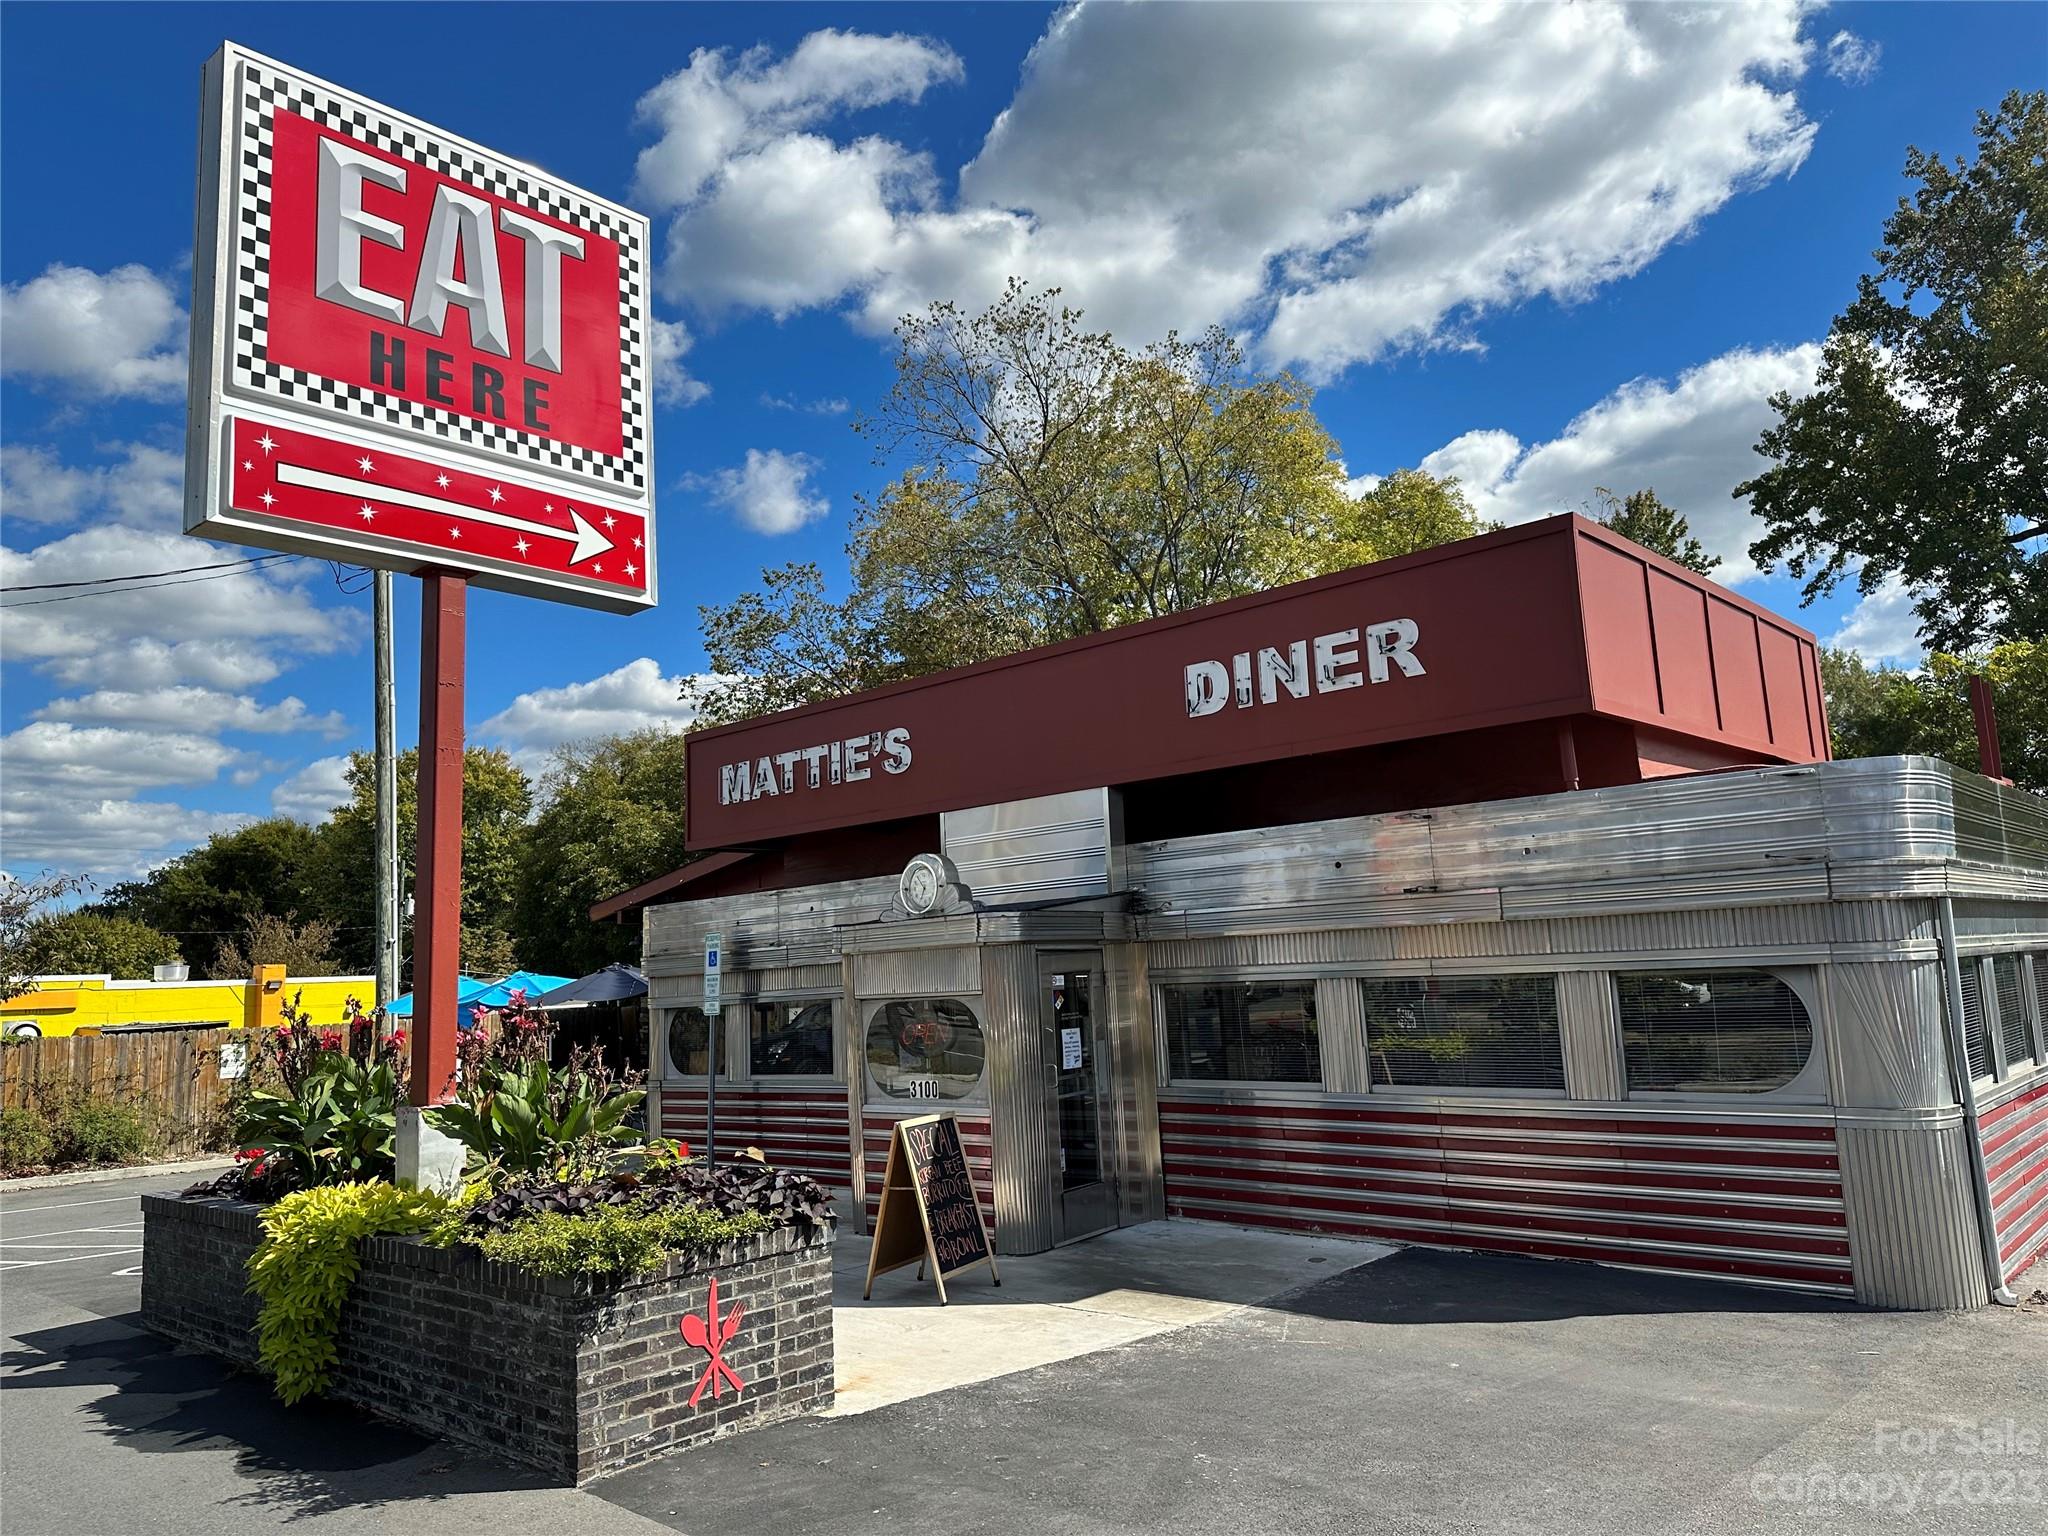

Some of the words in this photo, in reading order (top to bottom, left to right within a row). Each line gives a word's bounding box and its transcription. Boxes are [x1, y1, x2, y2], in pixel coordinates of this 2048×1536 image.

[315, 134, 586, 374] EAT
[370, 330, 550, 432] HERE
[718, 727, 913, 806] MATTIE'S
[1183, 617, 1428, 719] DINER
[902, 1022, 951, 1045] OPEN
[910, 1081, 939, 1098] 3100
[909, 1121, 960, 1166] SPECIAL
[933, 1201, 977, 1236] BREAKFAST
[950, 1231, 985, 1261] BOWL
